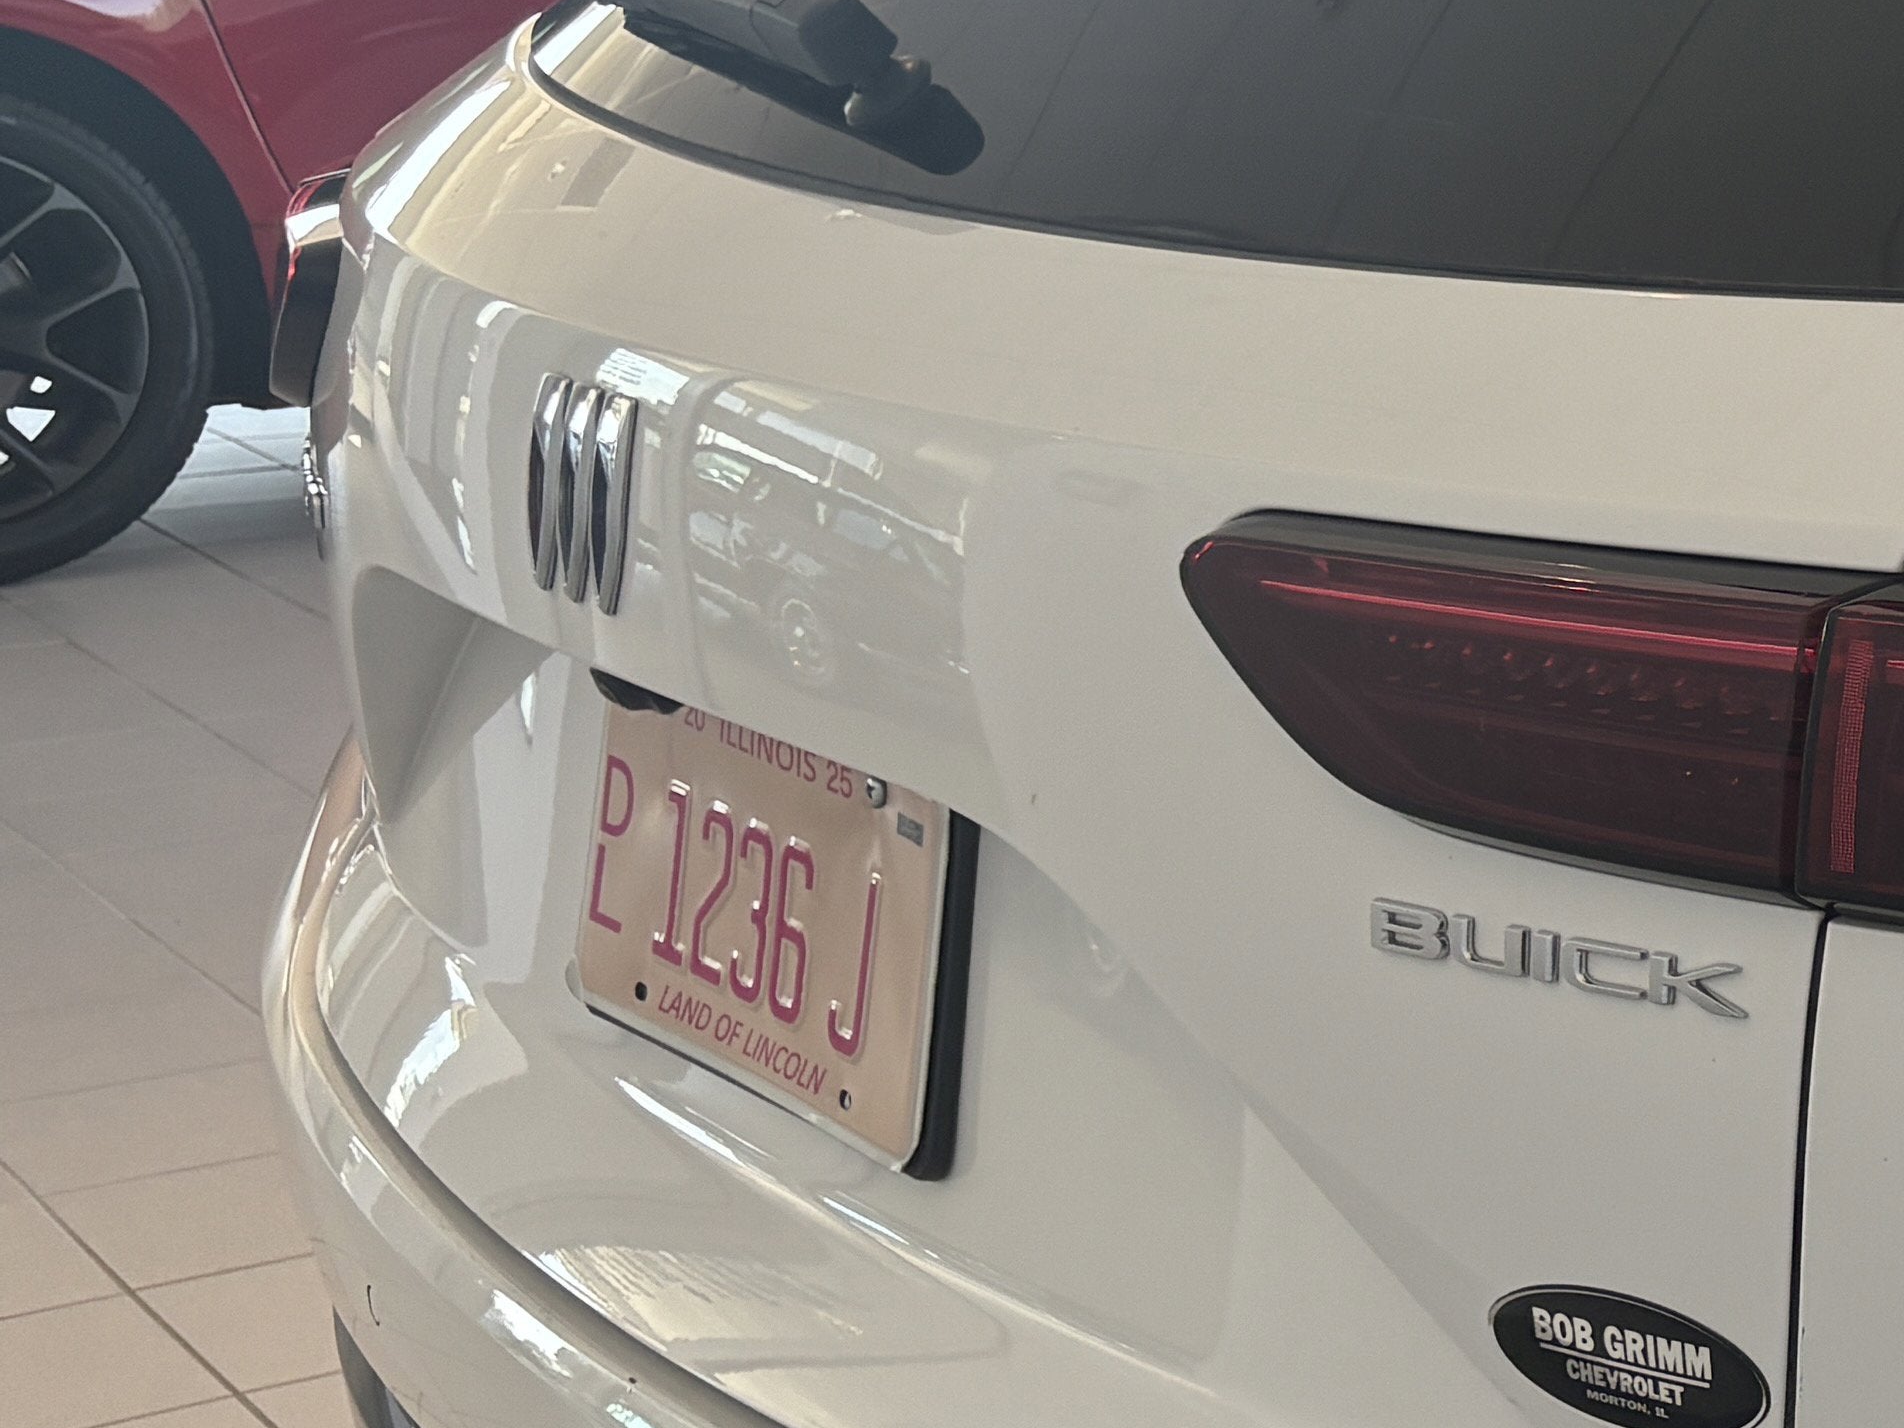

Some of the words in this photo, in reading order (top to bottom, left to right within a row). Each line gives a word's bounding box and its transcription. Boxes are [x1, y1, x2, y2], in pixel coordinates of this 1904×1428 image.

[684, 706, 706, 733] 20
[718, 718, 817, 783] ILLINOIS
[826, 759, 853, 799] 25
[651, 779, 815, 1025] 1236
[827, 872, 881, 1057] J
[1371, 897, 1749, 1019] BUICK
[658, 985, 712, 1031] LAND
[714, 1014, 744, 1046] OF
[742, 1028, 828, 1096] LINCOLN
[1531, 1306, 1595, 1352] BOB
[1603, 1325, 1714, 1381] GRIMM
[1565, 1358, 1685, 1407] CHEVROLET
[1586, 1389, 1651, 1416] MORTON,
[1655, 1406, 1670, 1420] IL
